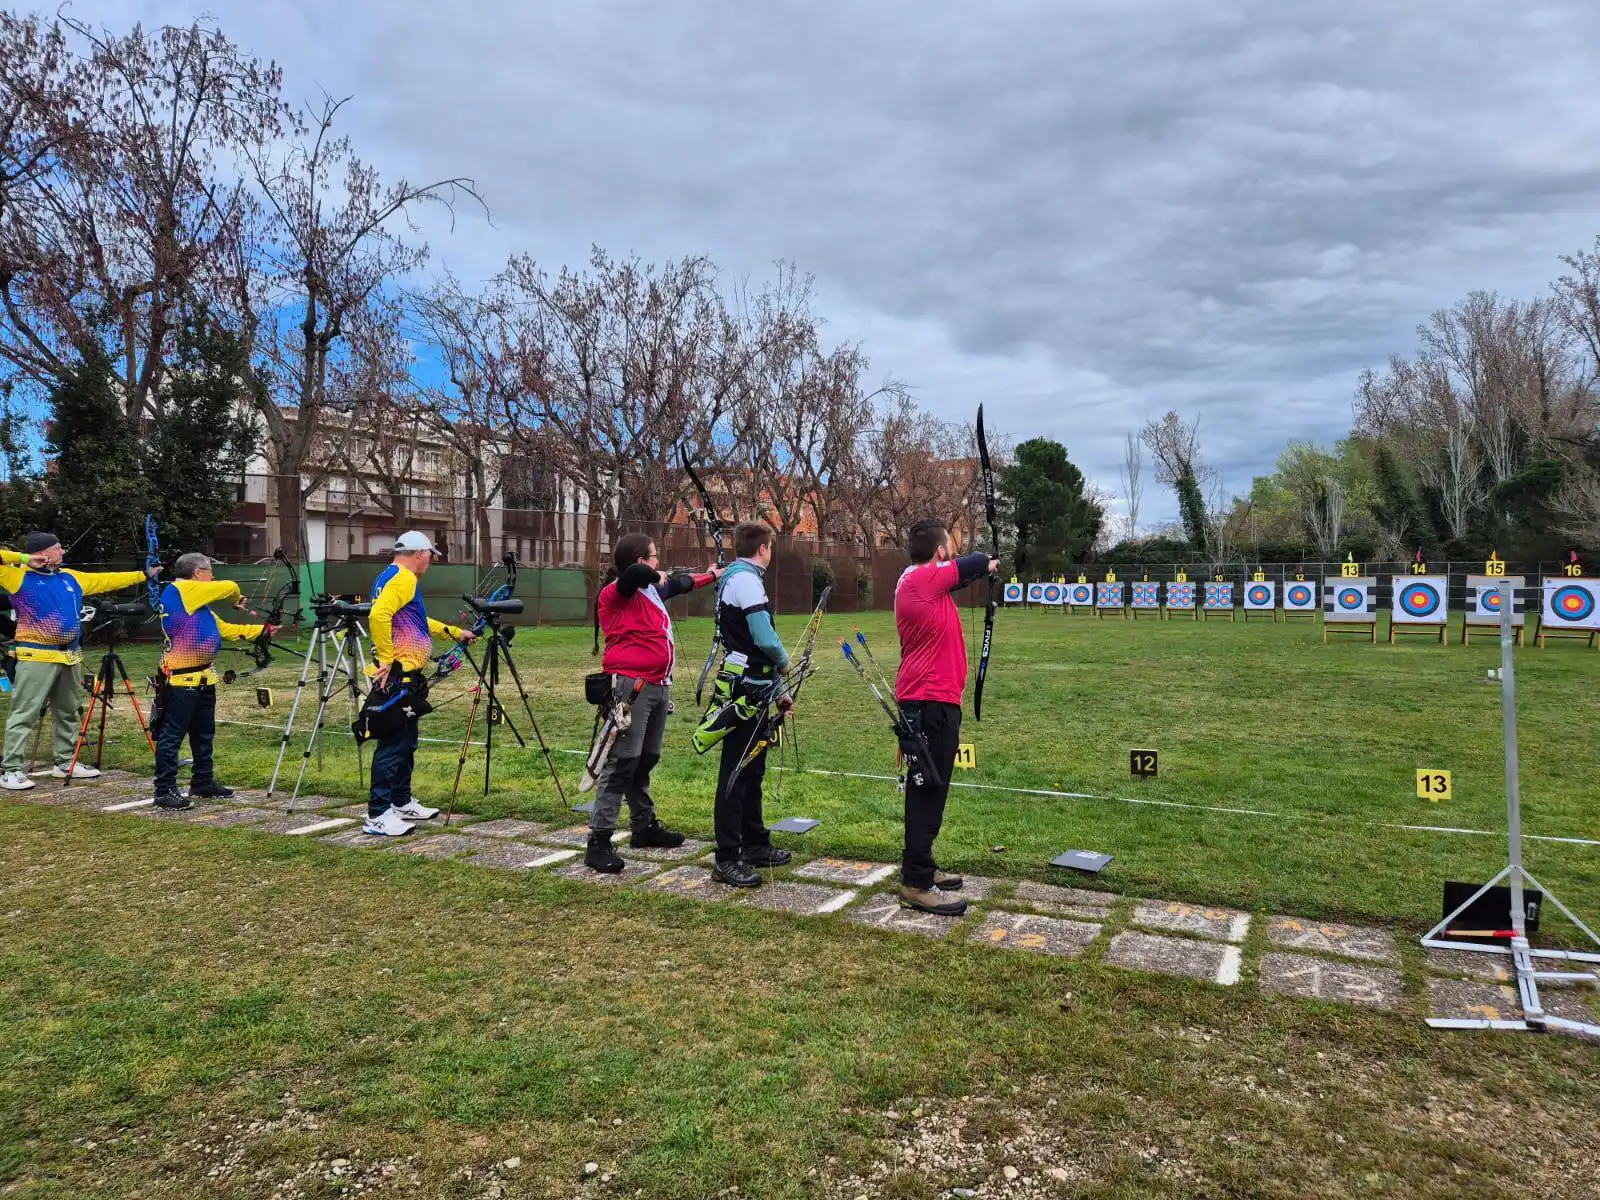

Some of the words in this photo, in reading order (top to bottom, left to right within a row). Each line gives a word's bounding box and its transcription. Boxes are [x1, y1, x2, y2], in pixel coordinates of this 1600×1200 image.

[1343, 565, 1358, 577] 13
[1411, 563, 1427, 575] 14
[1487, 562, 1503, 574] 15
[1564, 565, 1582, 577] 16
[955, 748, 970, 763] 11
[1134, 755, 1156, 771] 12
[1420, 775, 1448, 793] 13
